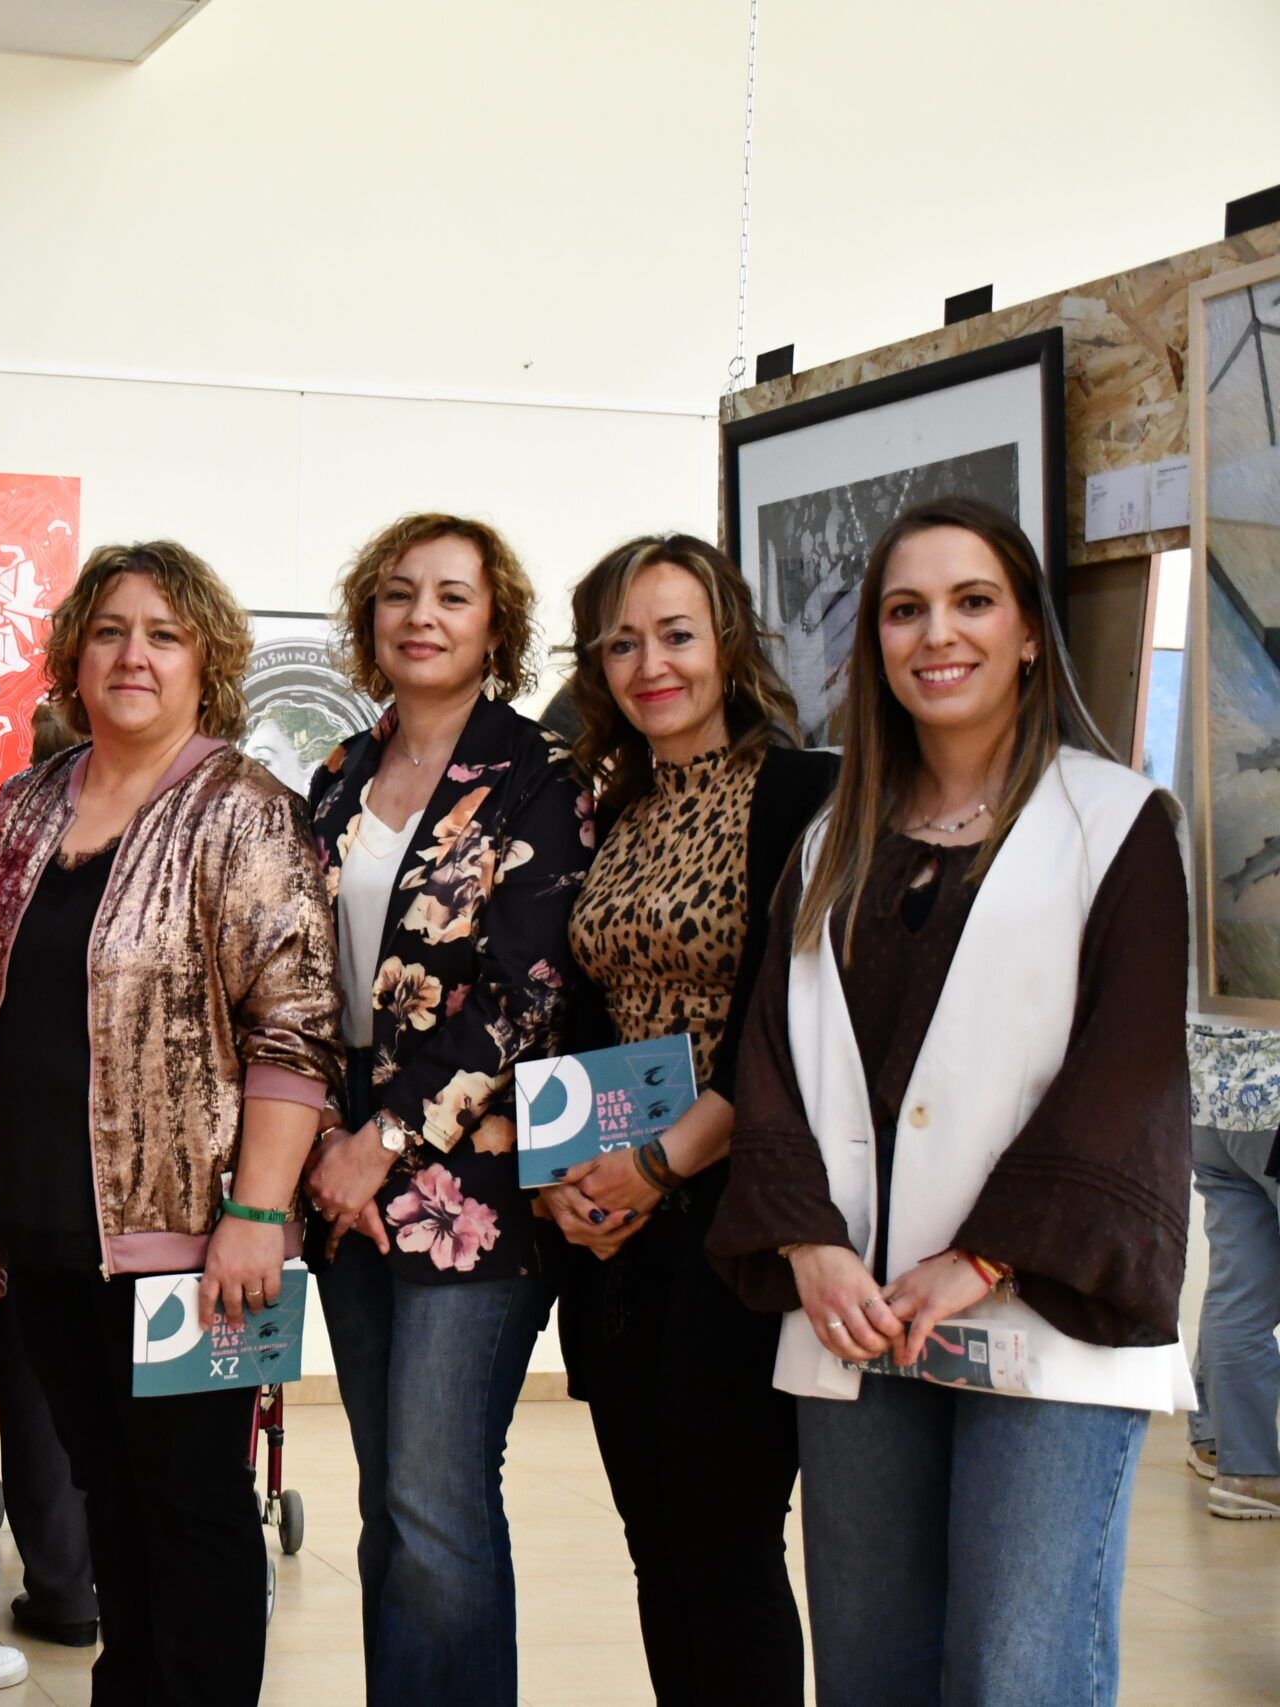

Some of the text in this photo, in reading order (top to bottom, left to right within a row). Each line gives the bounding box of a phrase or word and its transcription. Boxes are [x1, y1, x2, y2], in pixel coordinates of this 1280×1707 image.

[252, 651, 330, 671] YASHINON
[598, 1117, 633, 1132] TAS.
[211, 1335, 244, 1348] TAS.
[210, 1357, 239, 1377] X7
